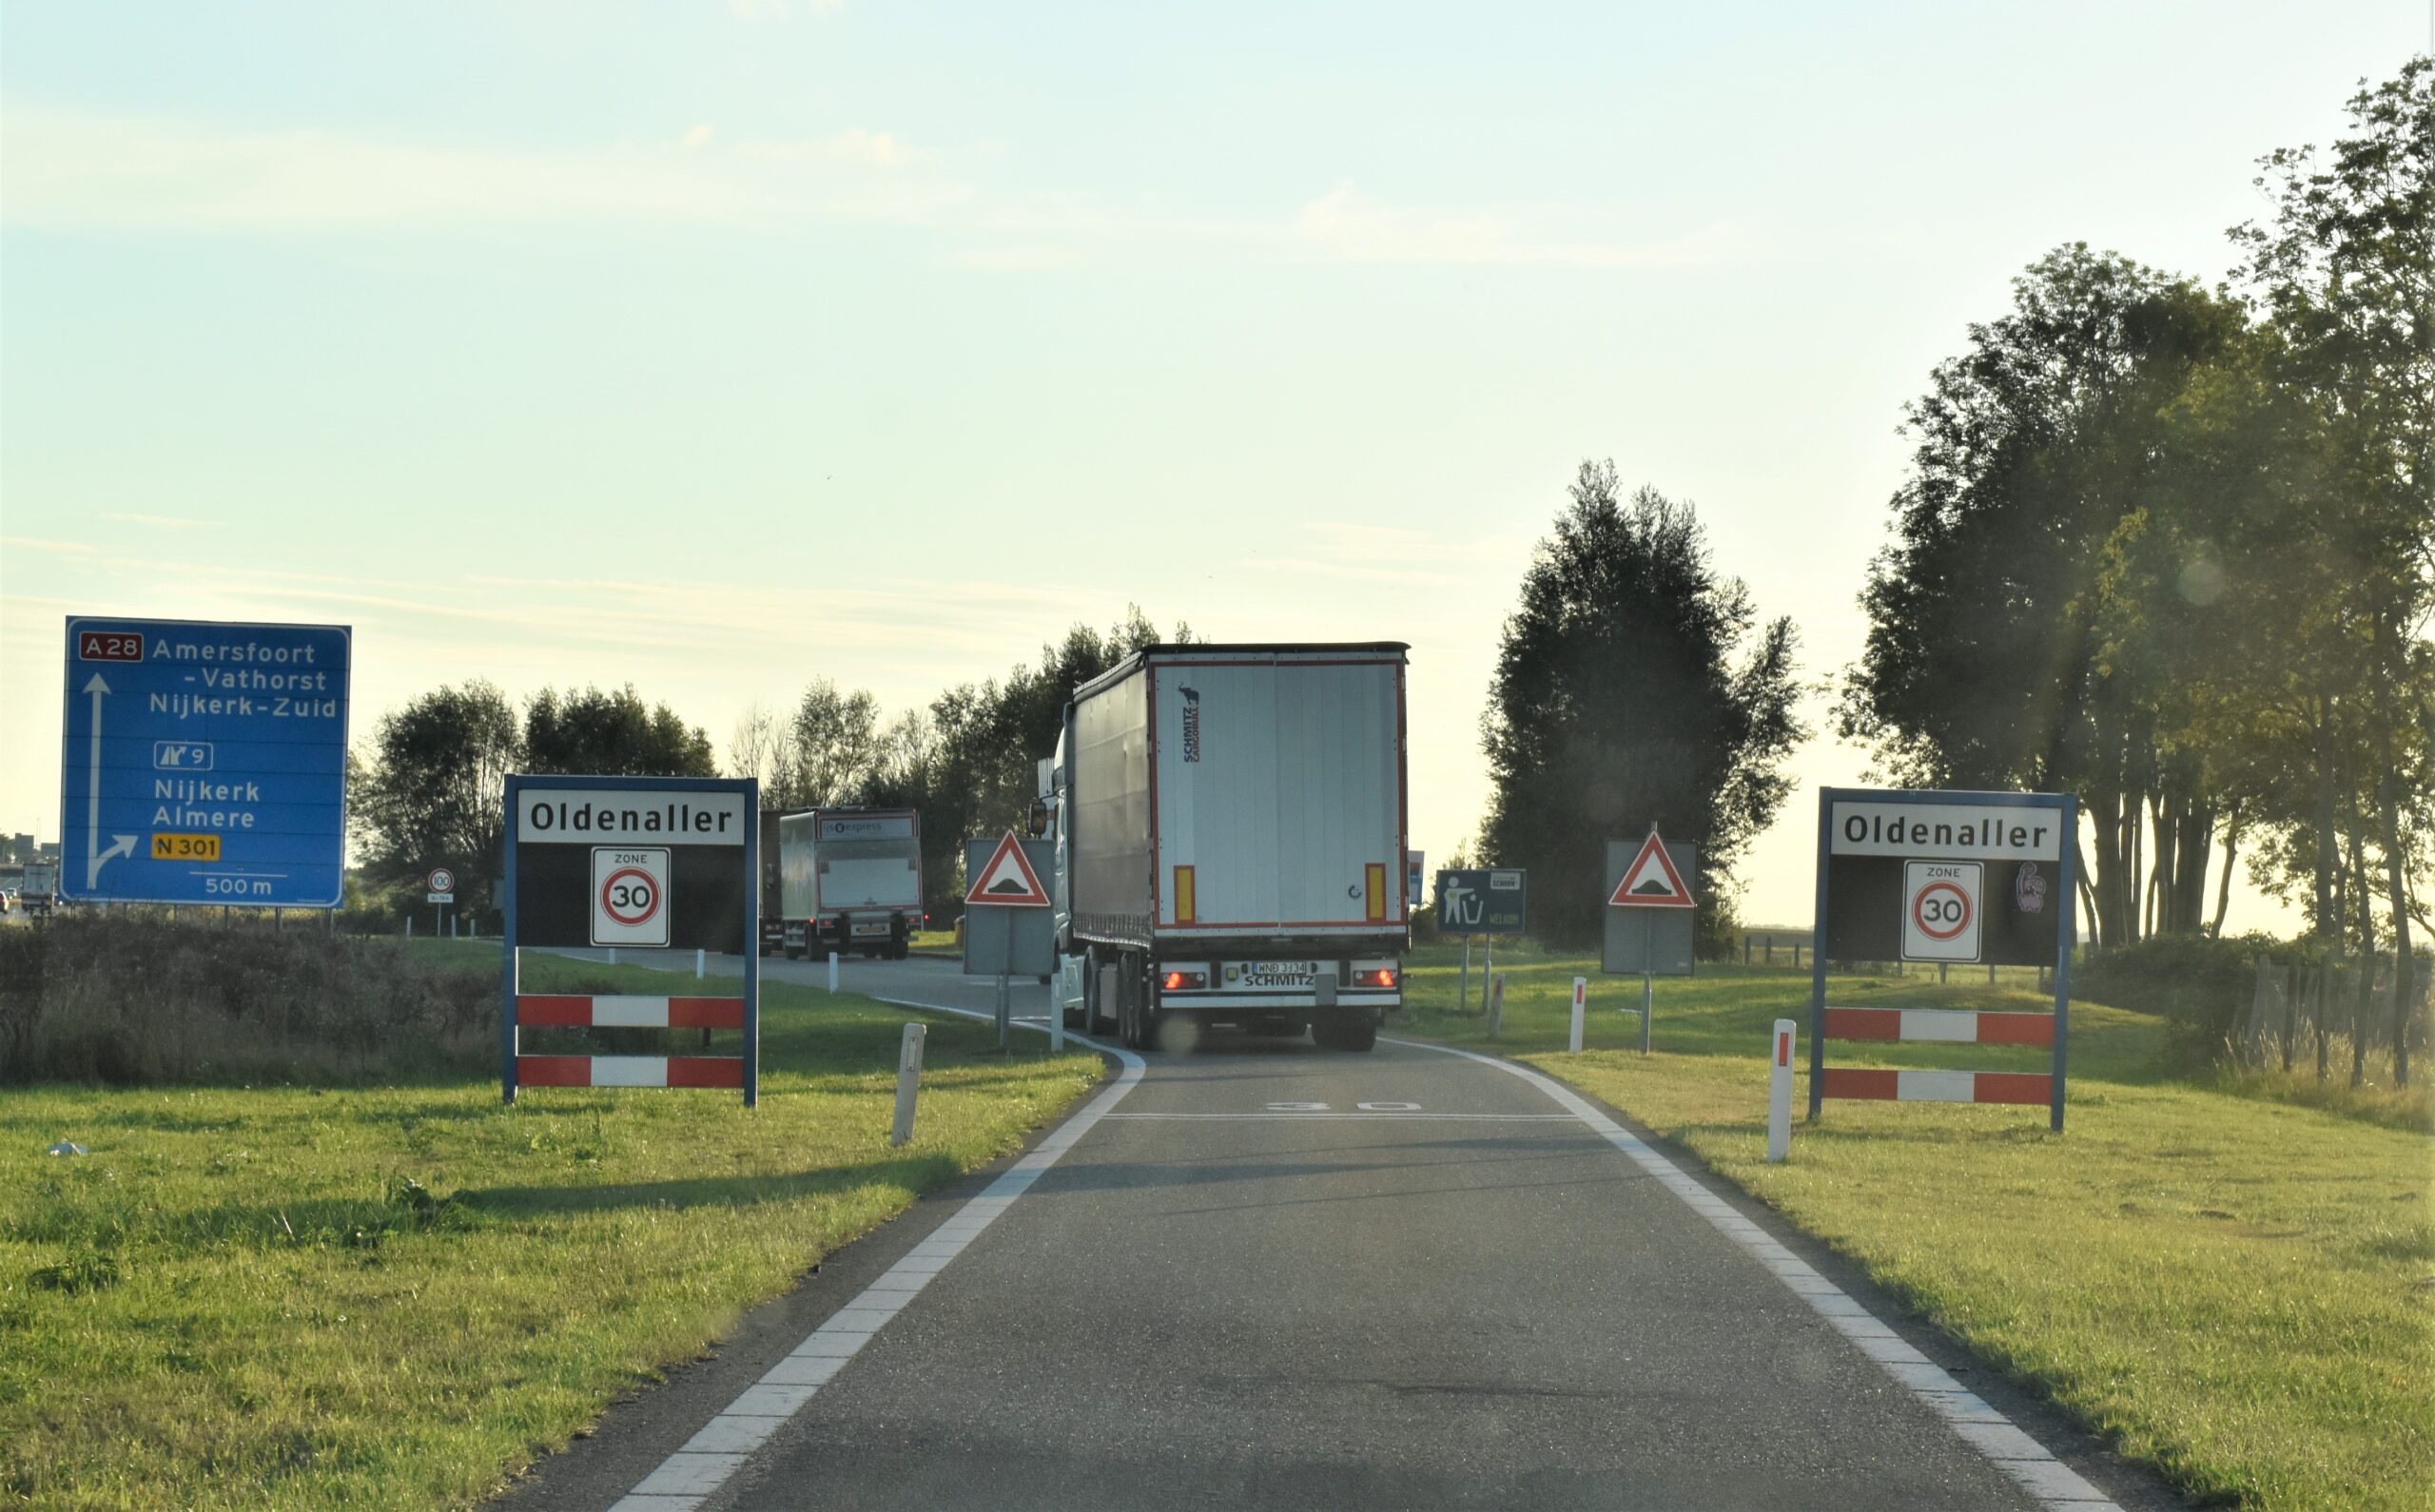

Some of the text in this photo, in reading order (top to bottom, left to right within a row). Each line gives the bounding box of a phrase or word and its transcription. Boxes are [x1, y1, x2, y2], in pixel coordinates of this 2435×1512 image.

[152, 639, 315, 663] Amersfoort
[184, 668, 326, 691] -Vathorst
[150, 692, 336, 719] Nijkerk-Zuid
[1182, 707, 1193, 763] SCHMITZ
[191, 747, 205, 764] 9
[155, 779, 260, 805] Nijkerk
[152, 805, 255, 828] Almere
[530, 802, 732, 832] Oldenaller
[1844, 815, 2048, 848] Oldenaller
[614, 854, 648, 864] ZONE
[434, 876, 450, 886] 100
[1926, 866, 1961, 878] ZONE
[205, 878, 272, 895] 500 m
[611, 885, 651, 909] 30
[1922, 899, 1962, 923] 30
[1244, 975, 1315, 986] SCHMITZ
